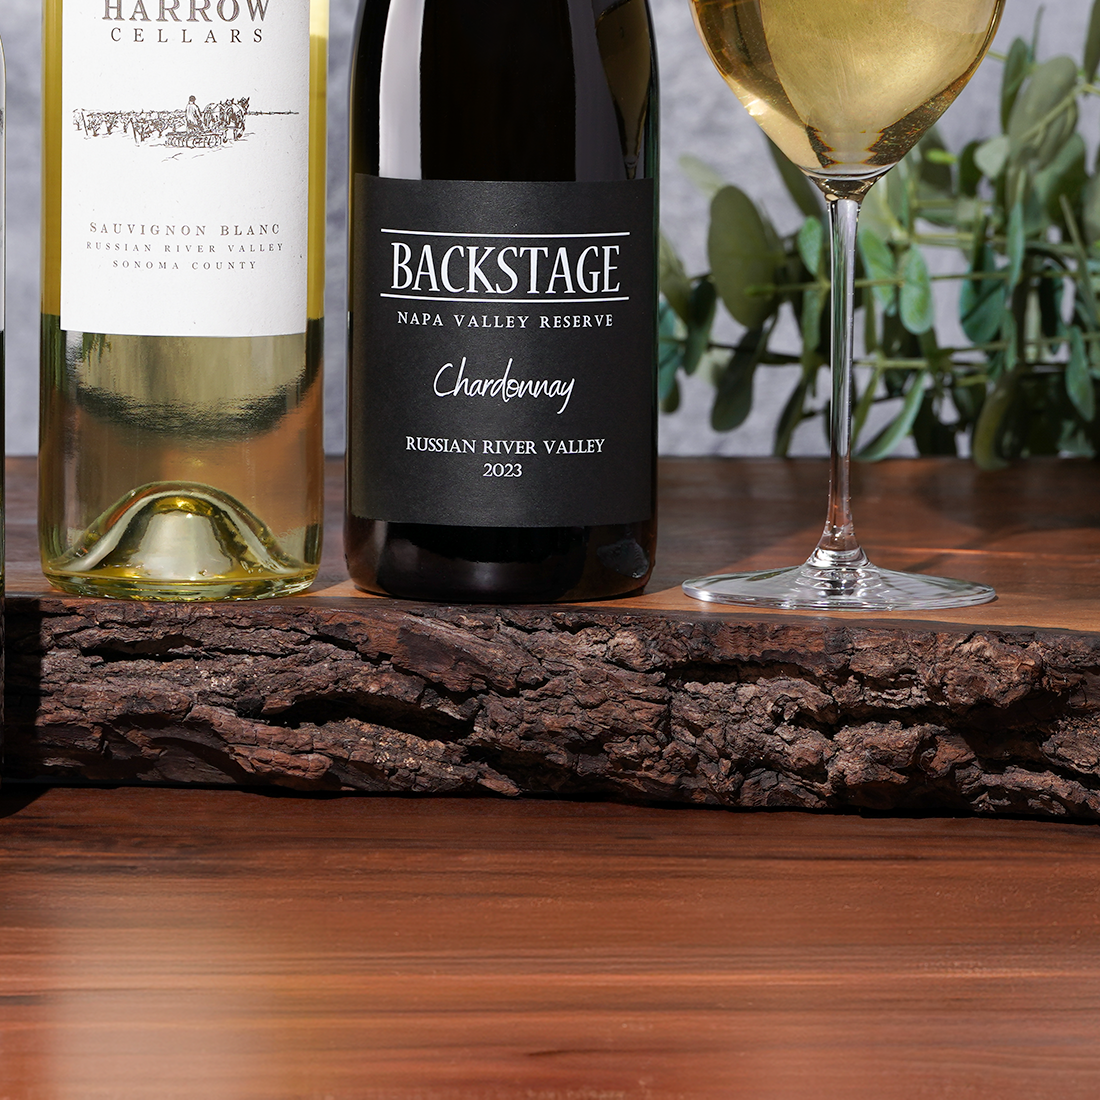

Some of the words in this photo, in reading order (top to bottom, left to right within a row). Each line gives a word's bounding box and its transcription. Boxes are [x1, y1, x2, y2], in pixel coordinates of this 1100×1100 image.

[110, 28, 263, 44] CELLARS
[89, 222, 206, 236] SAUVIGNON
[220, 223, 280, 236] BLANC
[86, 241, 152, 252] RUSSIAN
[164, 244, 216, 253] RIVER
[227, 243, 283, 253] VALLEY
[113, 260, 179, 270] SONOMA
[192, 261, 256, 270] COUNTY
[390, 241, 621, 294] BACKSTAGE
[397, 311, 444, 327] NAPA
[453, 314, 529, 329] VALLEY
[539, 314, 613, 328] RESERVE
[433, 356, 575, 415] Chardonnay
[405, 436, 476, 454] RUSSIAN
[482, 439, 538, 455] RIVER
[543, 438, 605, 455] VALLEY
[482, 463, 523, 478] 2023
